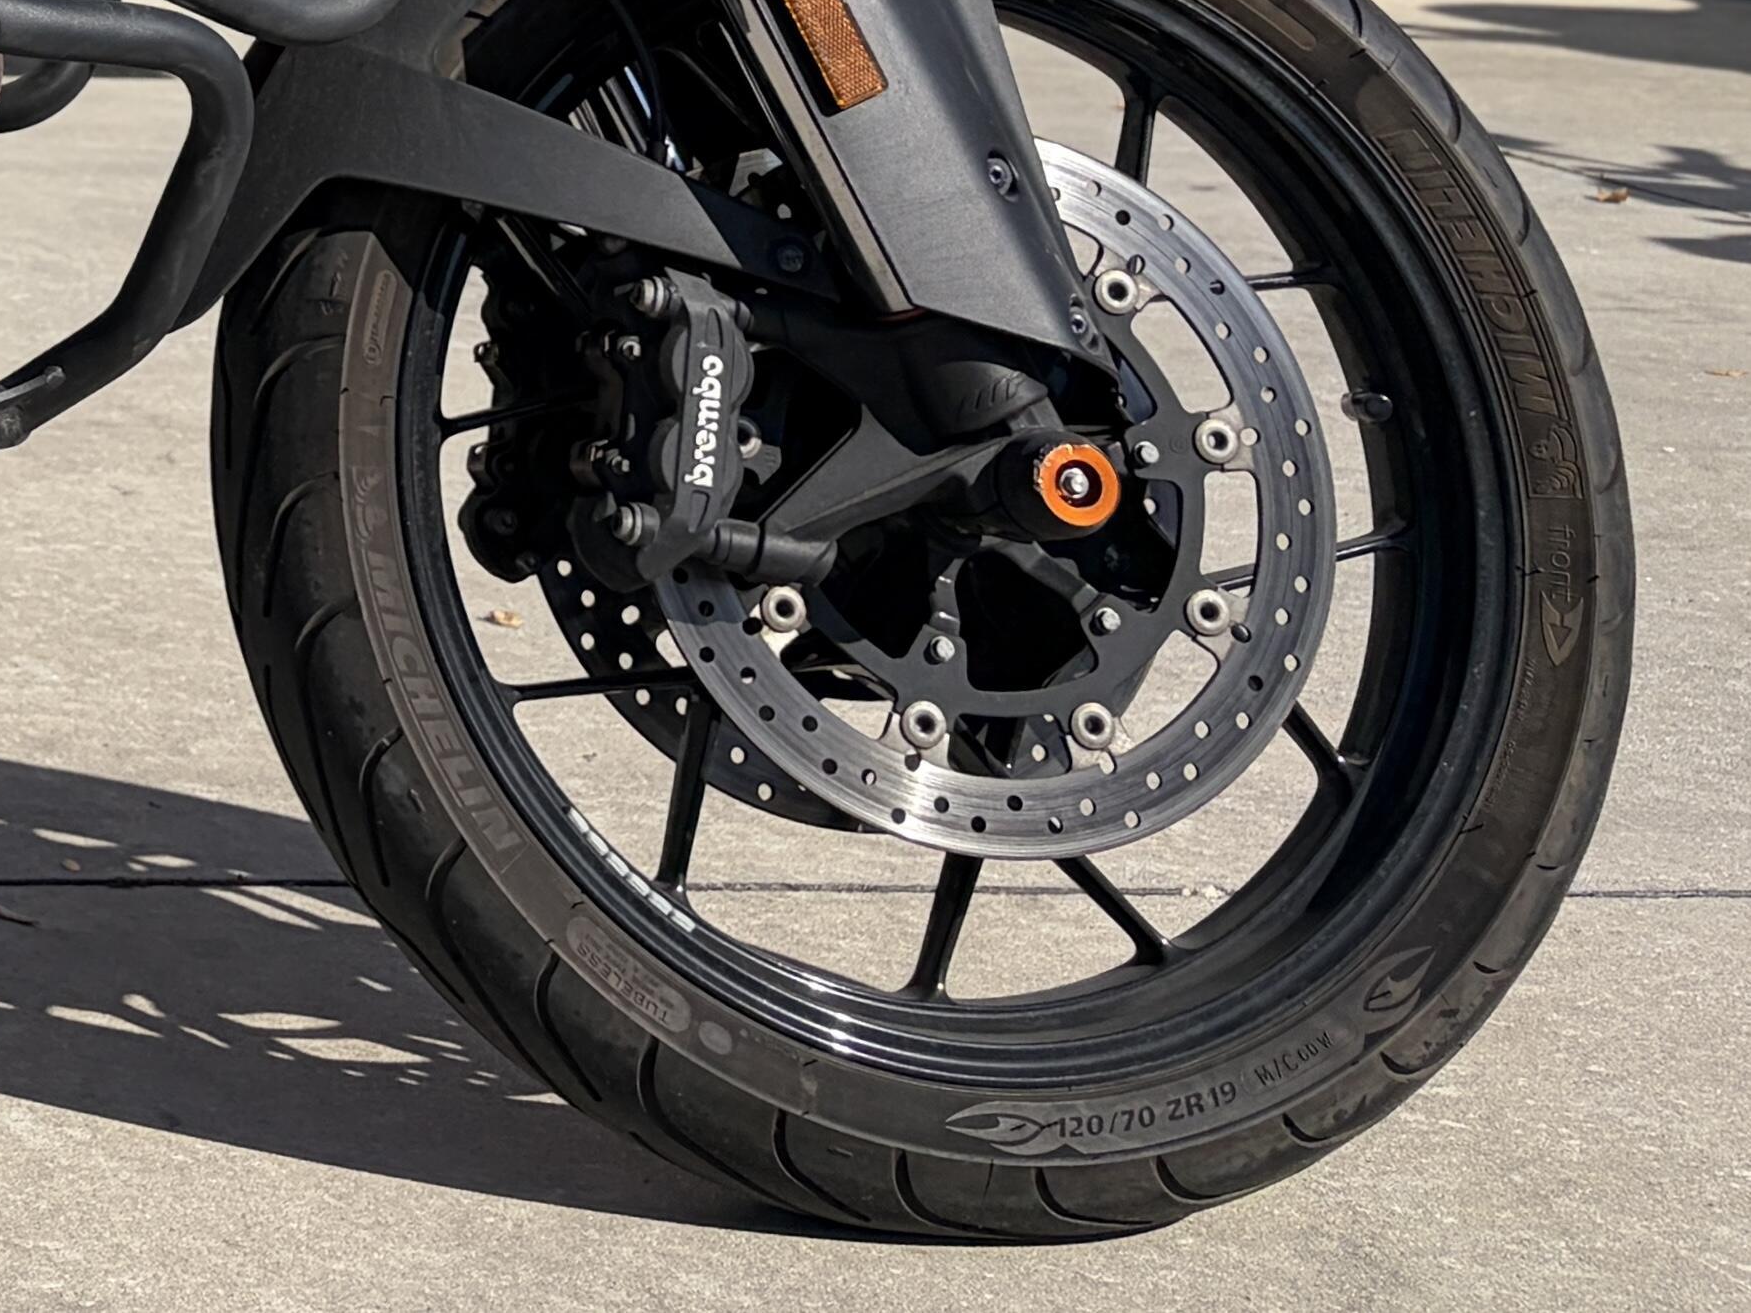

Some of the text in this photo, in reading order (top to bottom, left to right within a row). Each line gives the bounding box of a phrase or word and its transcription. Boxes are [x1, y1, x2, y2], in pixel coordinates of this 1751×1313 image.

[1383, 128, 1561, 417] MICHELIN
[684, 354, 724, 488] brembo
[1548, 524, 1577, 603] front
[366, 549, 523, 852] MICHELIN
[577, 942, 669, 1024] TUBELESS
[1057, 1106, 1156, 1138] 120/70
